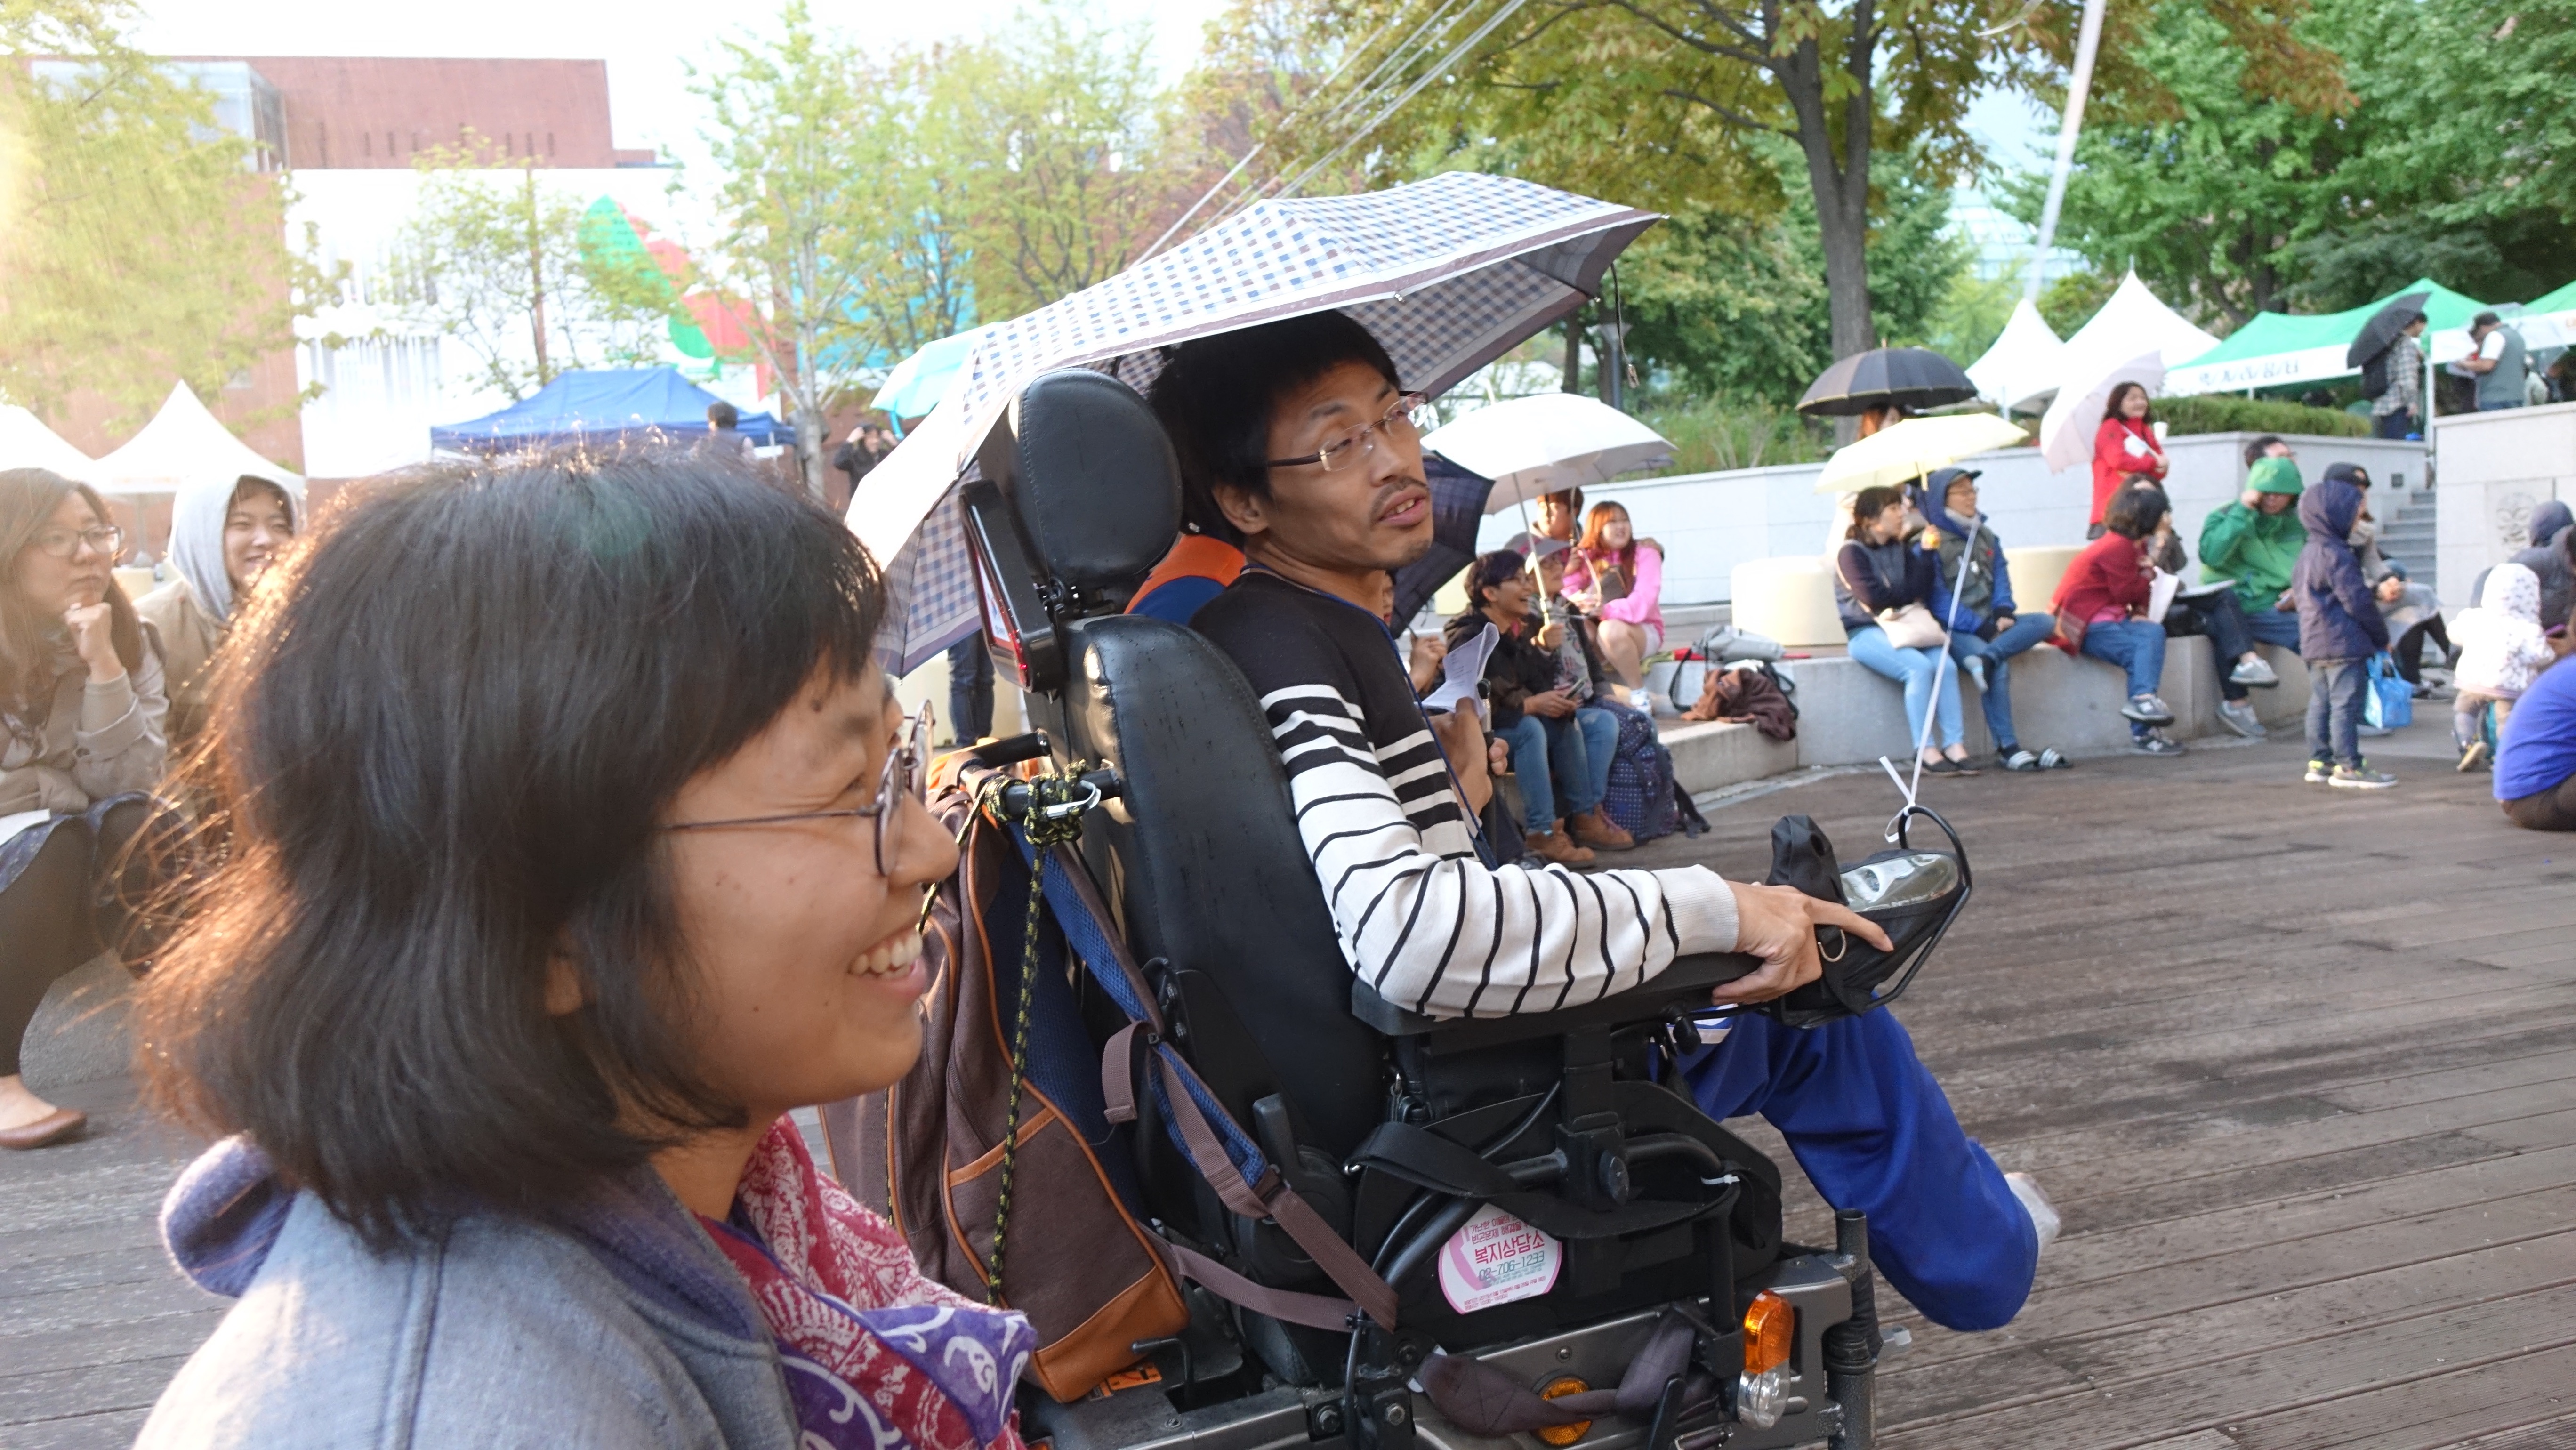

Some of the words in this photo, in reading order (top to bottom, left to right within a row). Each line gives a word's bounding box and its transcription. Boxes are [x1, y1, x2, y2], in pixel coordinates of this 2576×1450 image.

[1470, 1220, 1490, 1233] 가난한
[1472, 1228, 1499, 1244] 빈곤문제
[1474, 1230, 1545, 1264] 복지상담소
[1479, 1250, 1545, 1281] 02-706-1233
